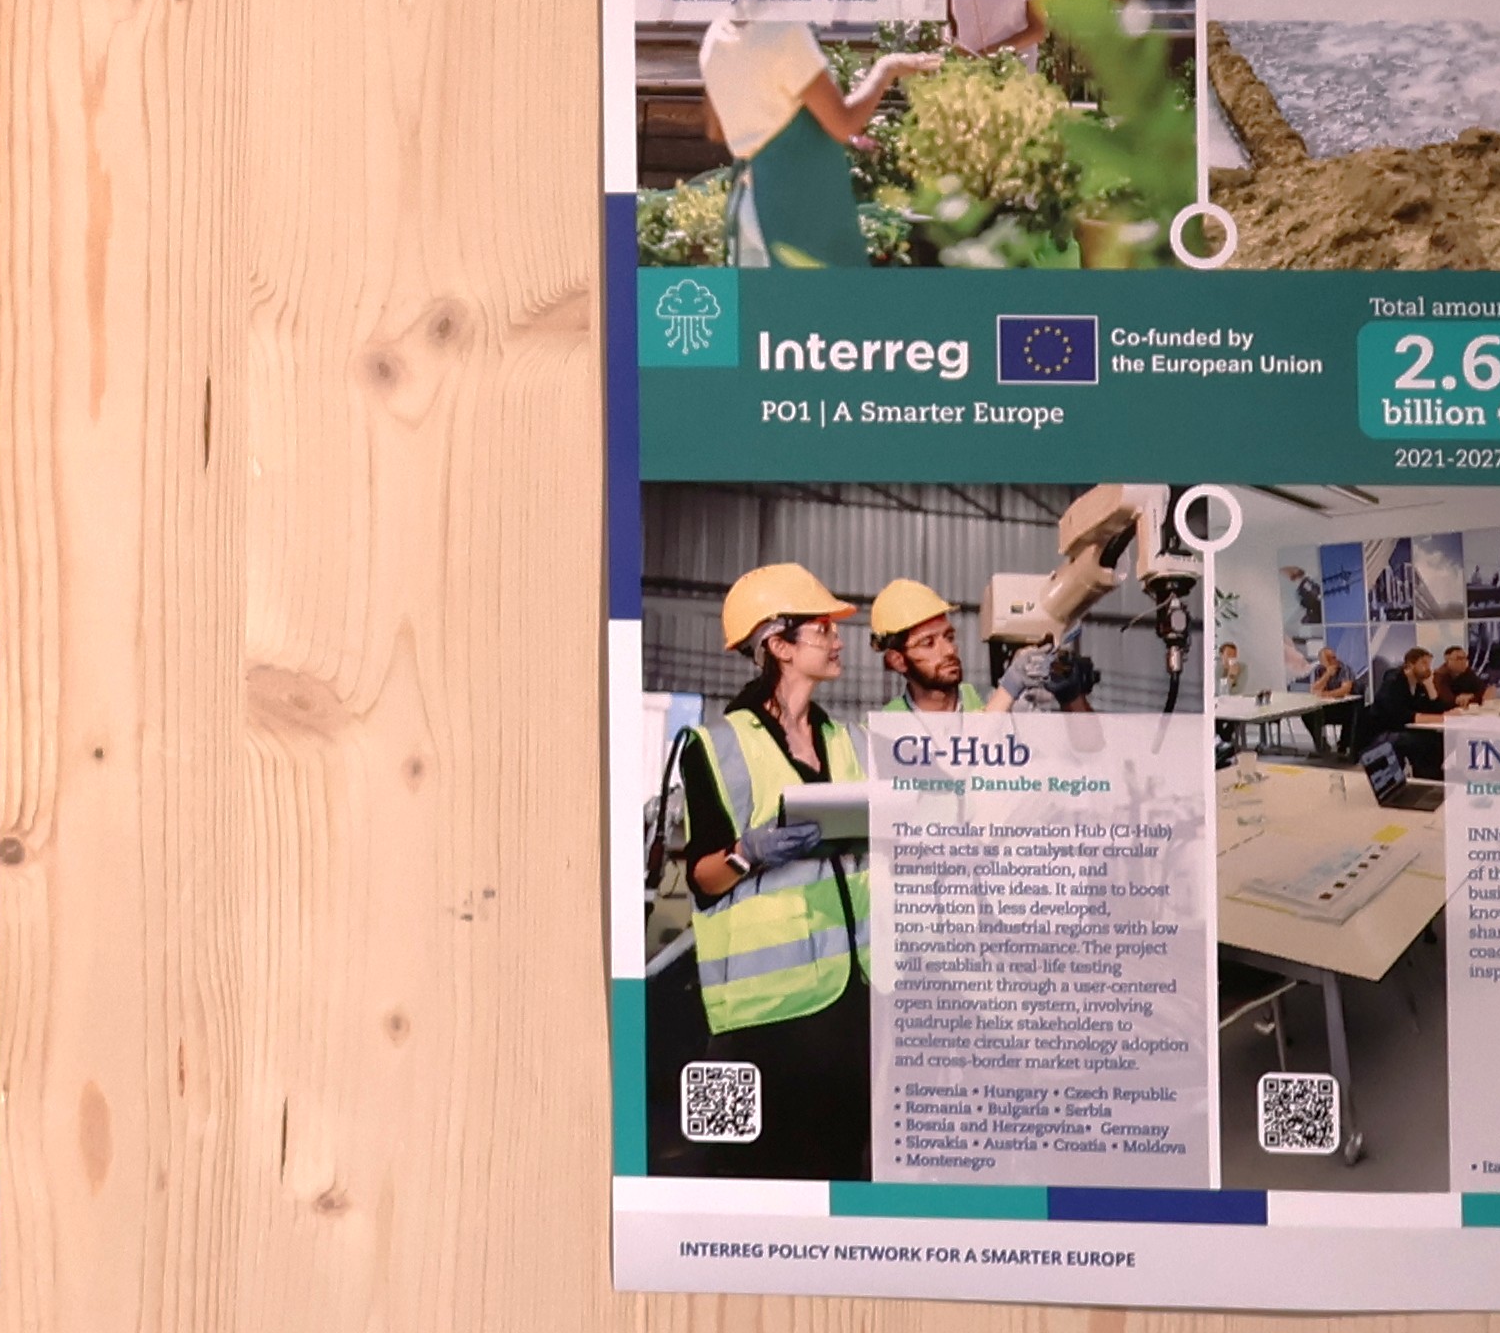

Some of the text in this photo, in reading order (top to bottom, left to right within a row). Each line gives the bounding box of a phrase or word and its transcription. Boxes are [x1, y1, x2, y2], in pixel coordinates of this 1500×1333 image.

[759, 330, 969, 380] Interreg
[761, 400, 1064, 430] PO1 A Smarter Europe
[892, 733, 1030, 767] CI-Hub
[891, 774, 1111, 797] Interreg Danube Region
